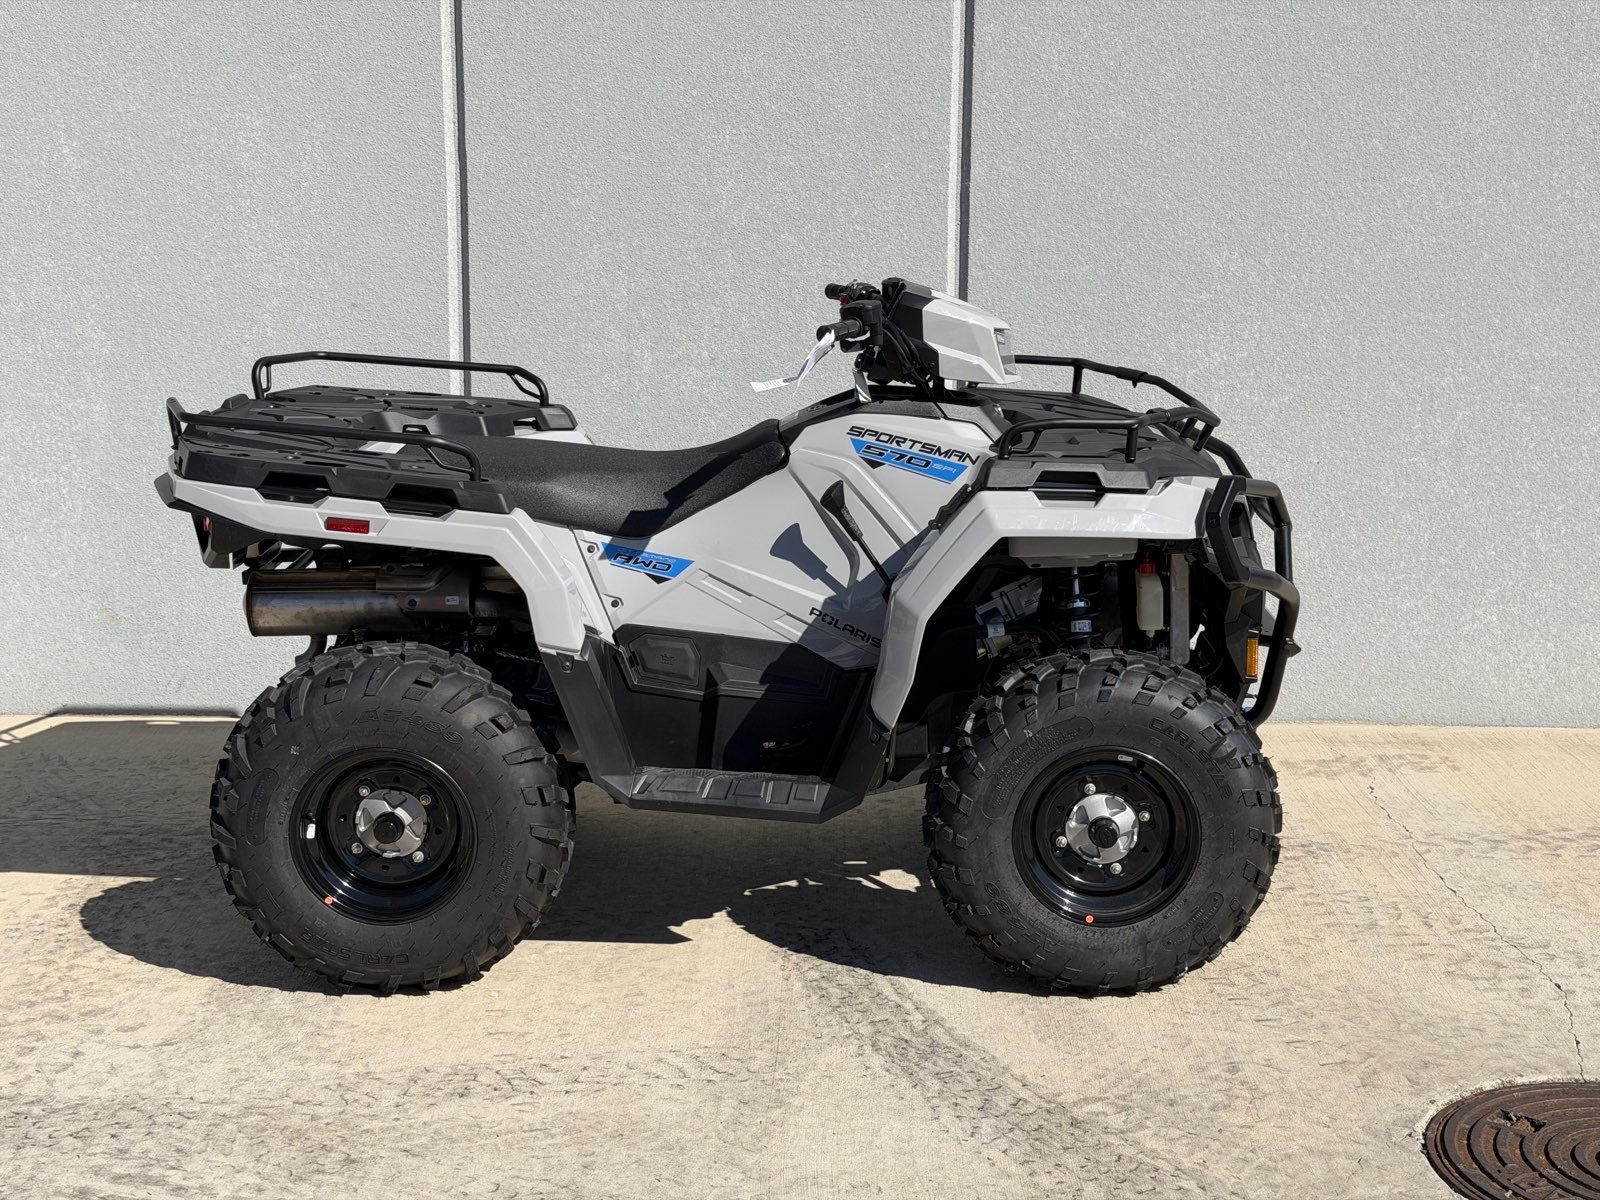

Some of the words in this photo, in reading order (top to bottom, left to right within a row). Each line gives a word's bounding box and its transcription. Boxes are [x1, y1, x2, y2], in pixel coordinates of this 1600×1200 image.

[846, 425, 980, 466] SPORTSMAN
[861, 444, 932, 469] 570
[932, 463, 957, 474] EFI
[612, 553, 673, 572] AWD
[808, 607, 883, 648] POLARIS
